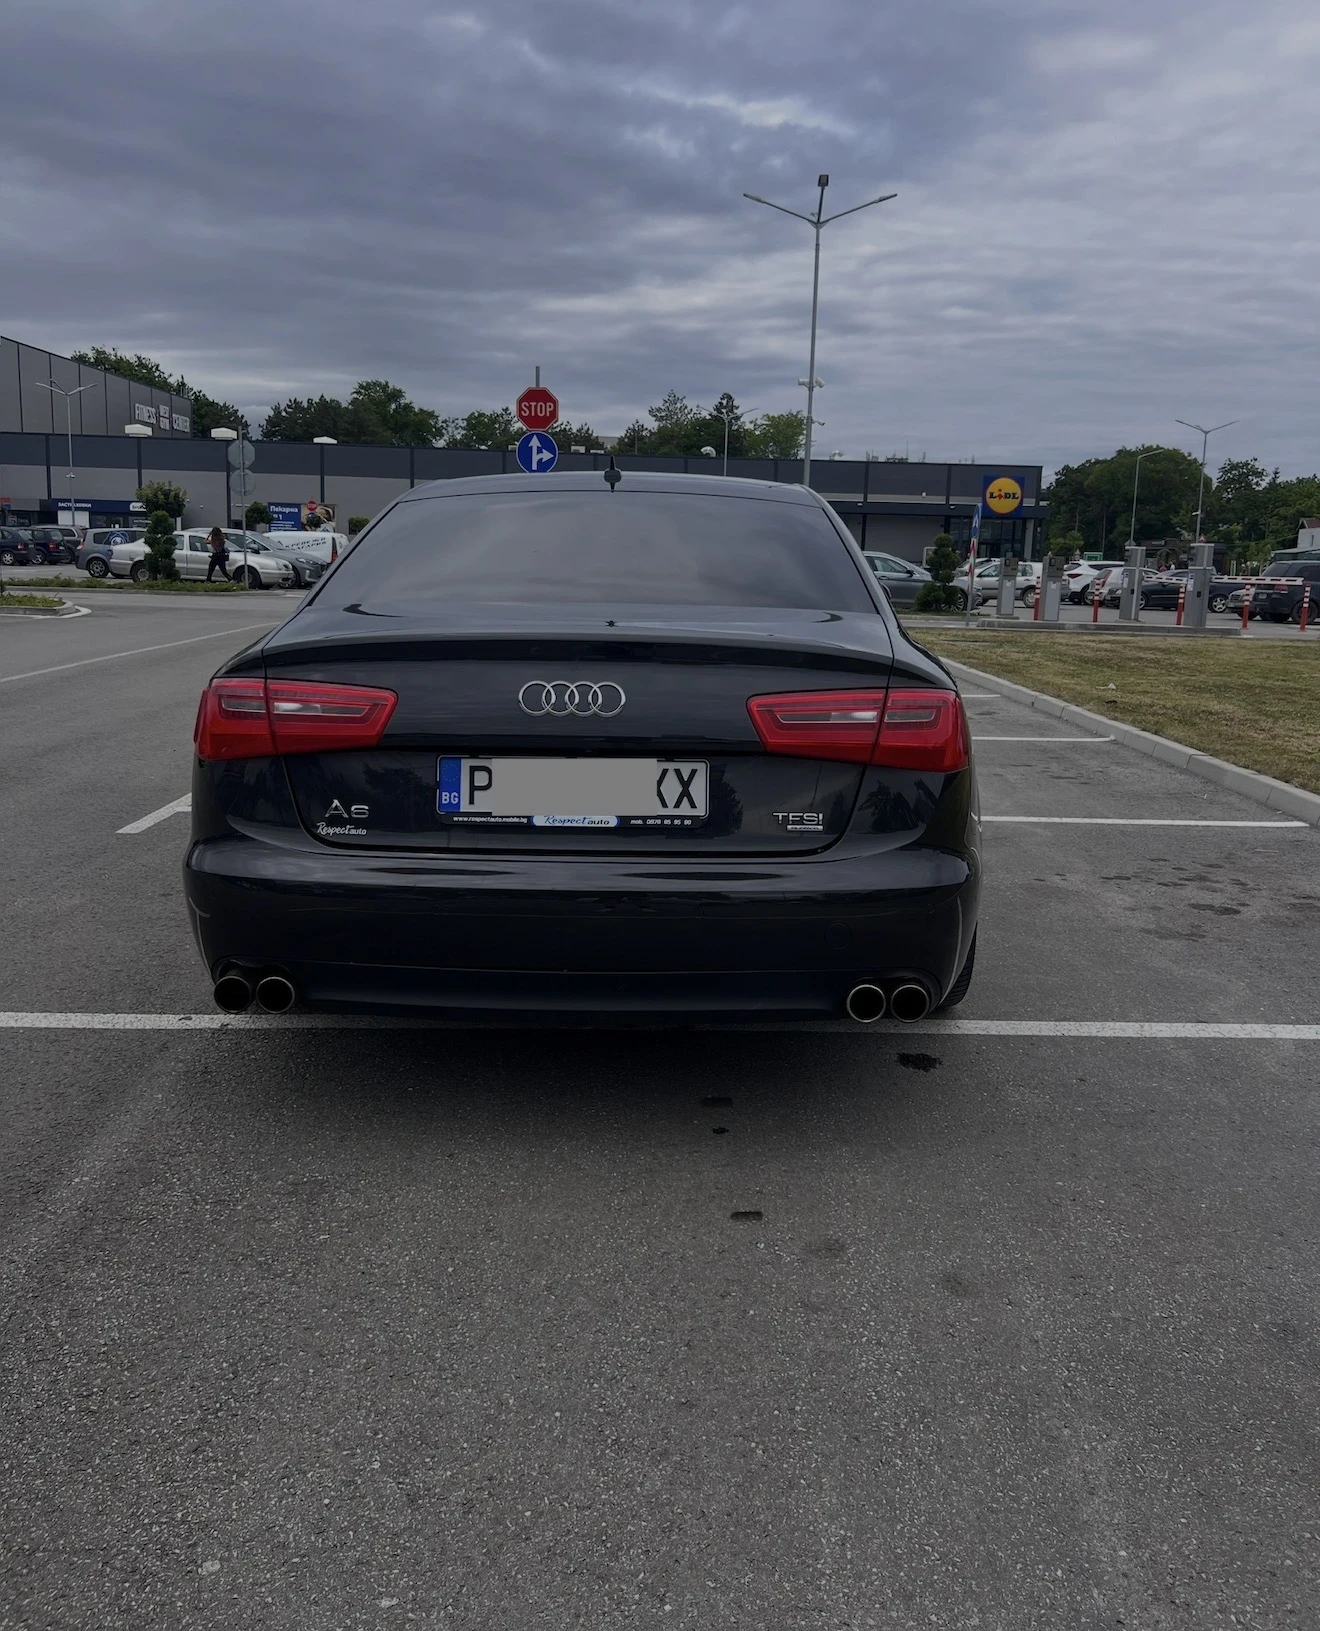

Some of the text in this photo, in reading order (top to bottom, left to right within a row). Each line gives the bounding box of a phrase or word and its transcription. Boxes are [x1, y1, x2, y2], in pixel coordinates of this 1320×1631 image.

[135, 403, 157, 424] FITNESS
[521, 401, 554, 417] STOP
[468, 765, 493, 805] P
[441, 792, 459, 804] BG
[325, 799, 369, 818] A6
[772, 812, 823, 824] TFSI
